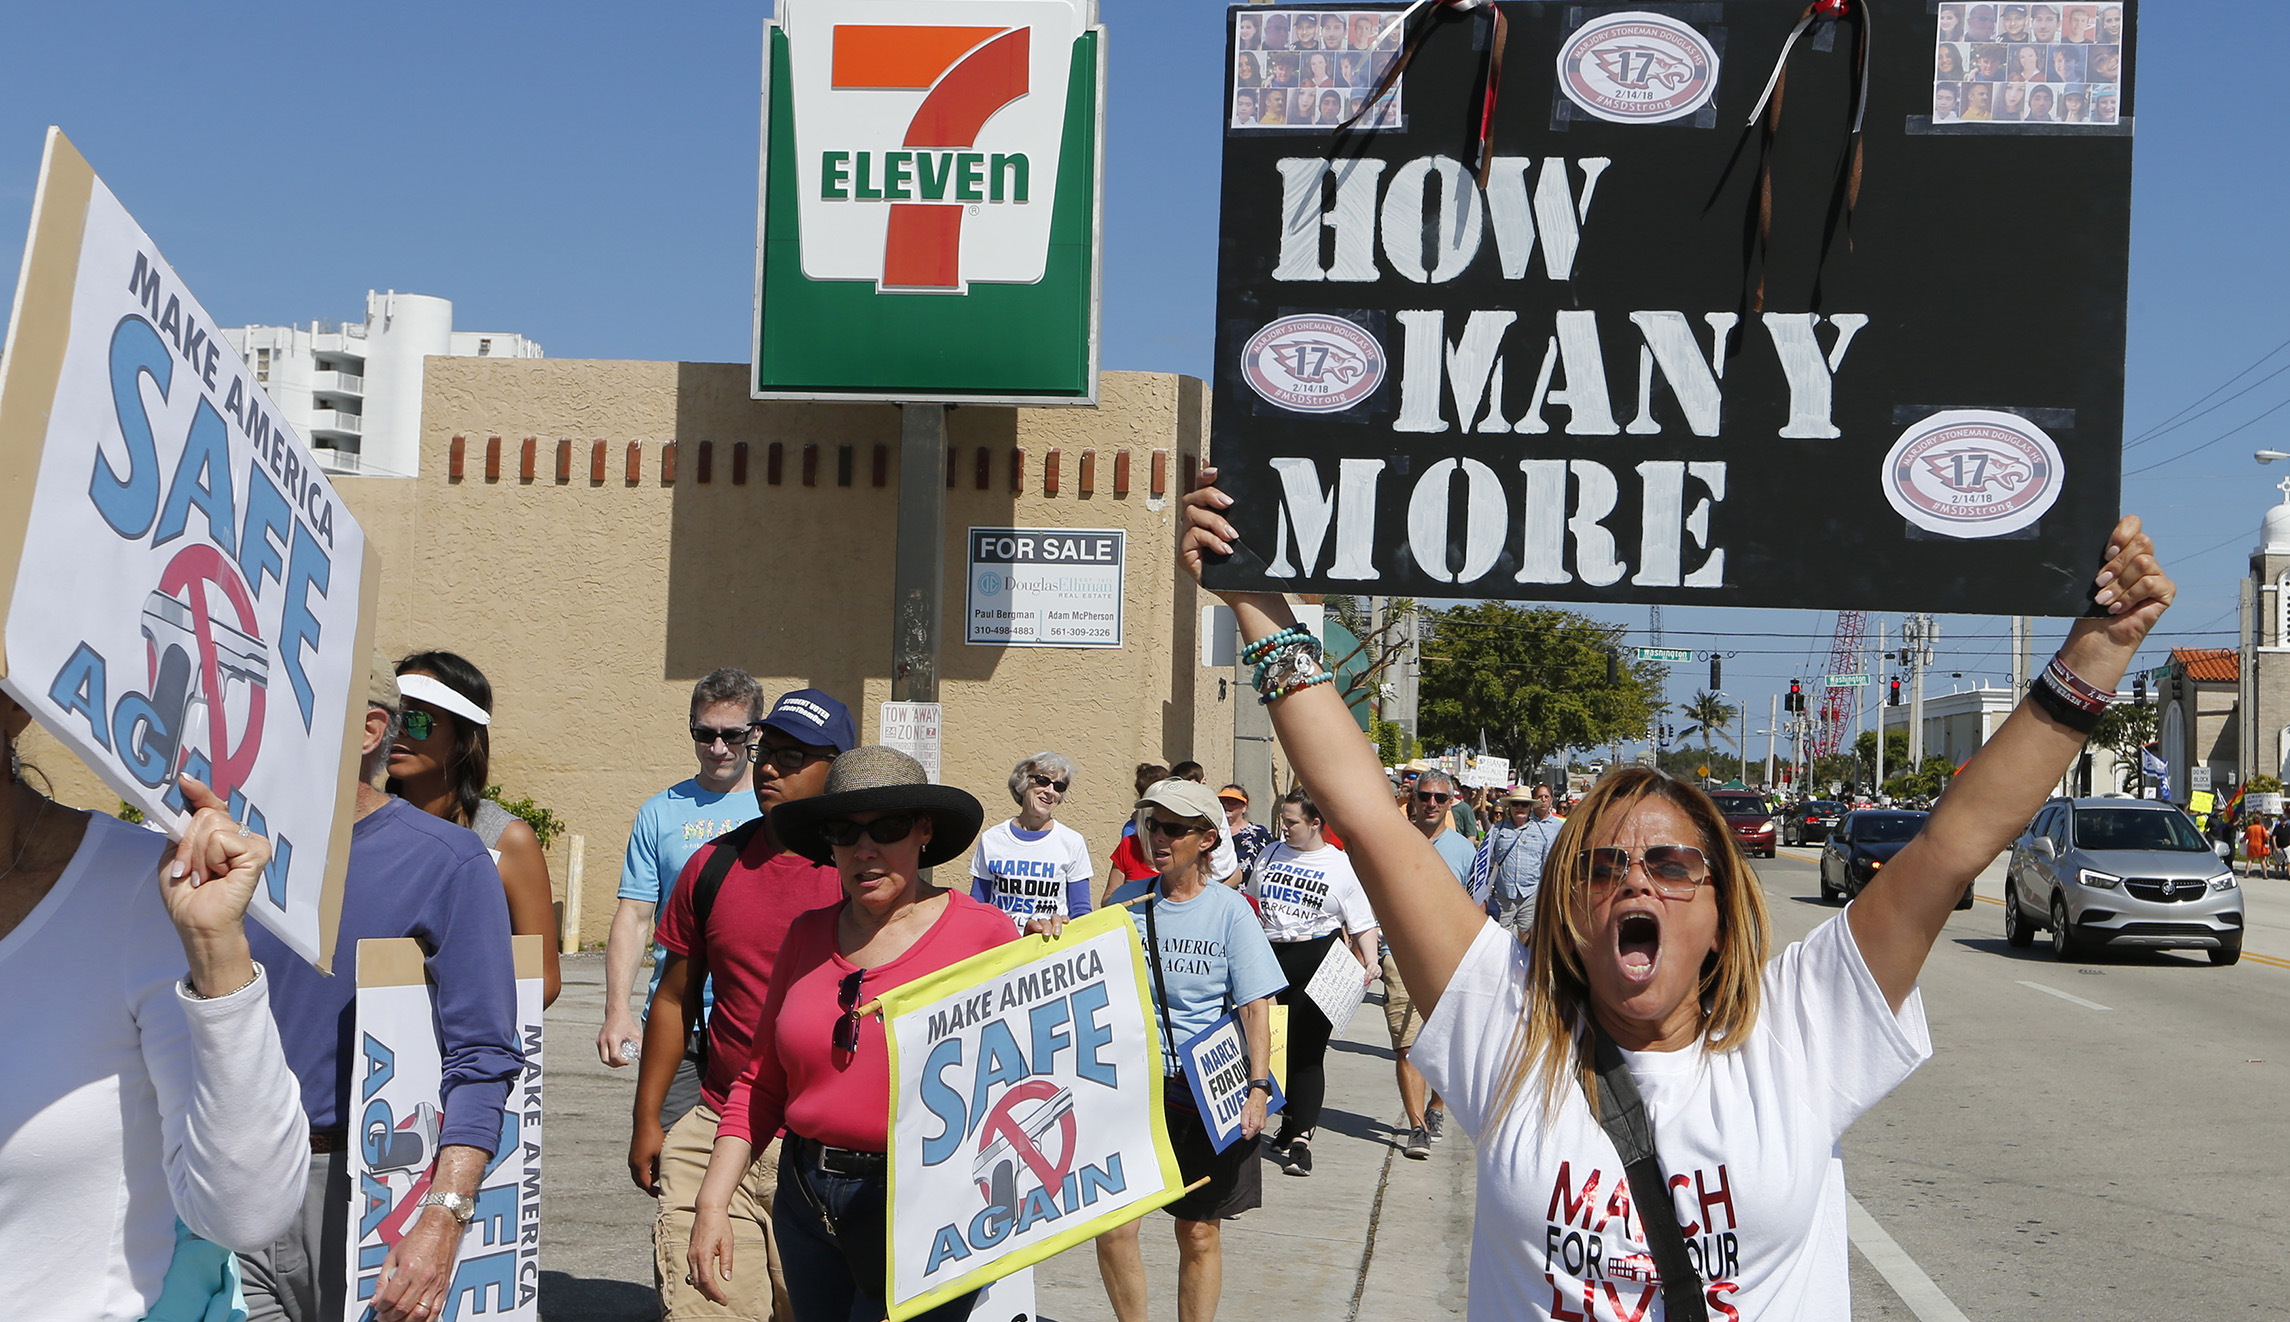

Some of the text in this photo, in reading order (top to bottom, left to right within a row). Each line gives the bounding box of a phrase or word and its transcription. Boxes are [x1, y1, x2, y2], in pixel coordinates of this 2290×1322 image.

[1574, 27, 1704, 66] MARJORY STONEMAN DOUGLAS HS
[1618, 52, 1655, 82] 17
[1596, 95, 1673, 111] #MSDStrong
[1615, 90, 1653, 100] 2/14/18
[832, 24, 1031, 290] 7
[1271, 154, 1611, 284] HOW
[1253, 322, 1376, 360] MARJORY STONEMAN DOUGLAS HS
[1295, 346, 1330, 376] 17
[1393, 309, 1869, 439] MANY
[129, 250, 333, 551] MAKE AMERICA
[1274, 388, 1347, 404] #MSDStrong
[1292, 383, 1329, 393] 2/14/18
[1903, 429, 2041, 466] MARJORY STONEMAN DOUGLAS HS
[1950, 454, 1990, 486] 17
[1931, 501, 2014, 516] #MSDStrong
[1951, 494, 1992, 504] 2/14/18
[88, 313, 331, 738] SAFE
[1264, 457, 1727, 588] MORE
[980, 537, 1112, 561] FOR SALE
[974, 609, 1035, 621] Paul Bergman
[1048, 610, 1114, 621] Adam McPherson
[974, 626, 1035, 636] 310-498-4883
[1050, 628, 1111, 637] 561-309-2326
[1644, 650, 1687, 659] Washington
[808, 703, 831, 720] VOTER
[885, 706, 937, 723] TOW AWAY
[898, 724, 926, 740] ZONE
[989, 860, 1055, 878] MARCH
[1025, 880, 1060, 897] OUR
[1261, 885, 1302, 904] LIVES
[1263, 872, 1330, 897] FOR OUR
[1161, 938, 1227, 958] AMERICA
[1164, 957, 1212, 975] AGAIN
[927, 949, 1104, 1045] MAKE AMERICA
[1200, 1036, 1240, 1078] MARCH
[920, 980, 1118, 1167] SAFE
[1208, 1068, 1237, 1101] FOR
[518, 1024, 543, 1309] MAKE AMERICA
[923, 1151, 1127, 1277] AGAIN
[1547, 1160, 1737, 1243] MACH
[1545, 1225, 1603, 1279] FOR
[1545, 1273, 1740, 1322] LIVS
